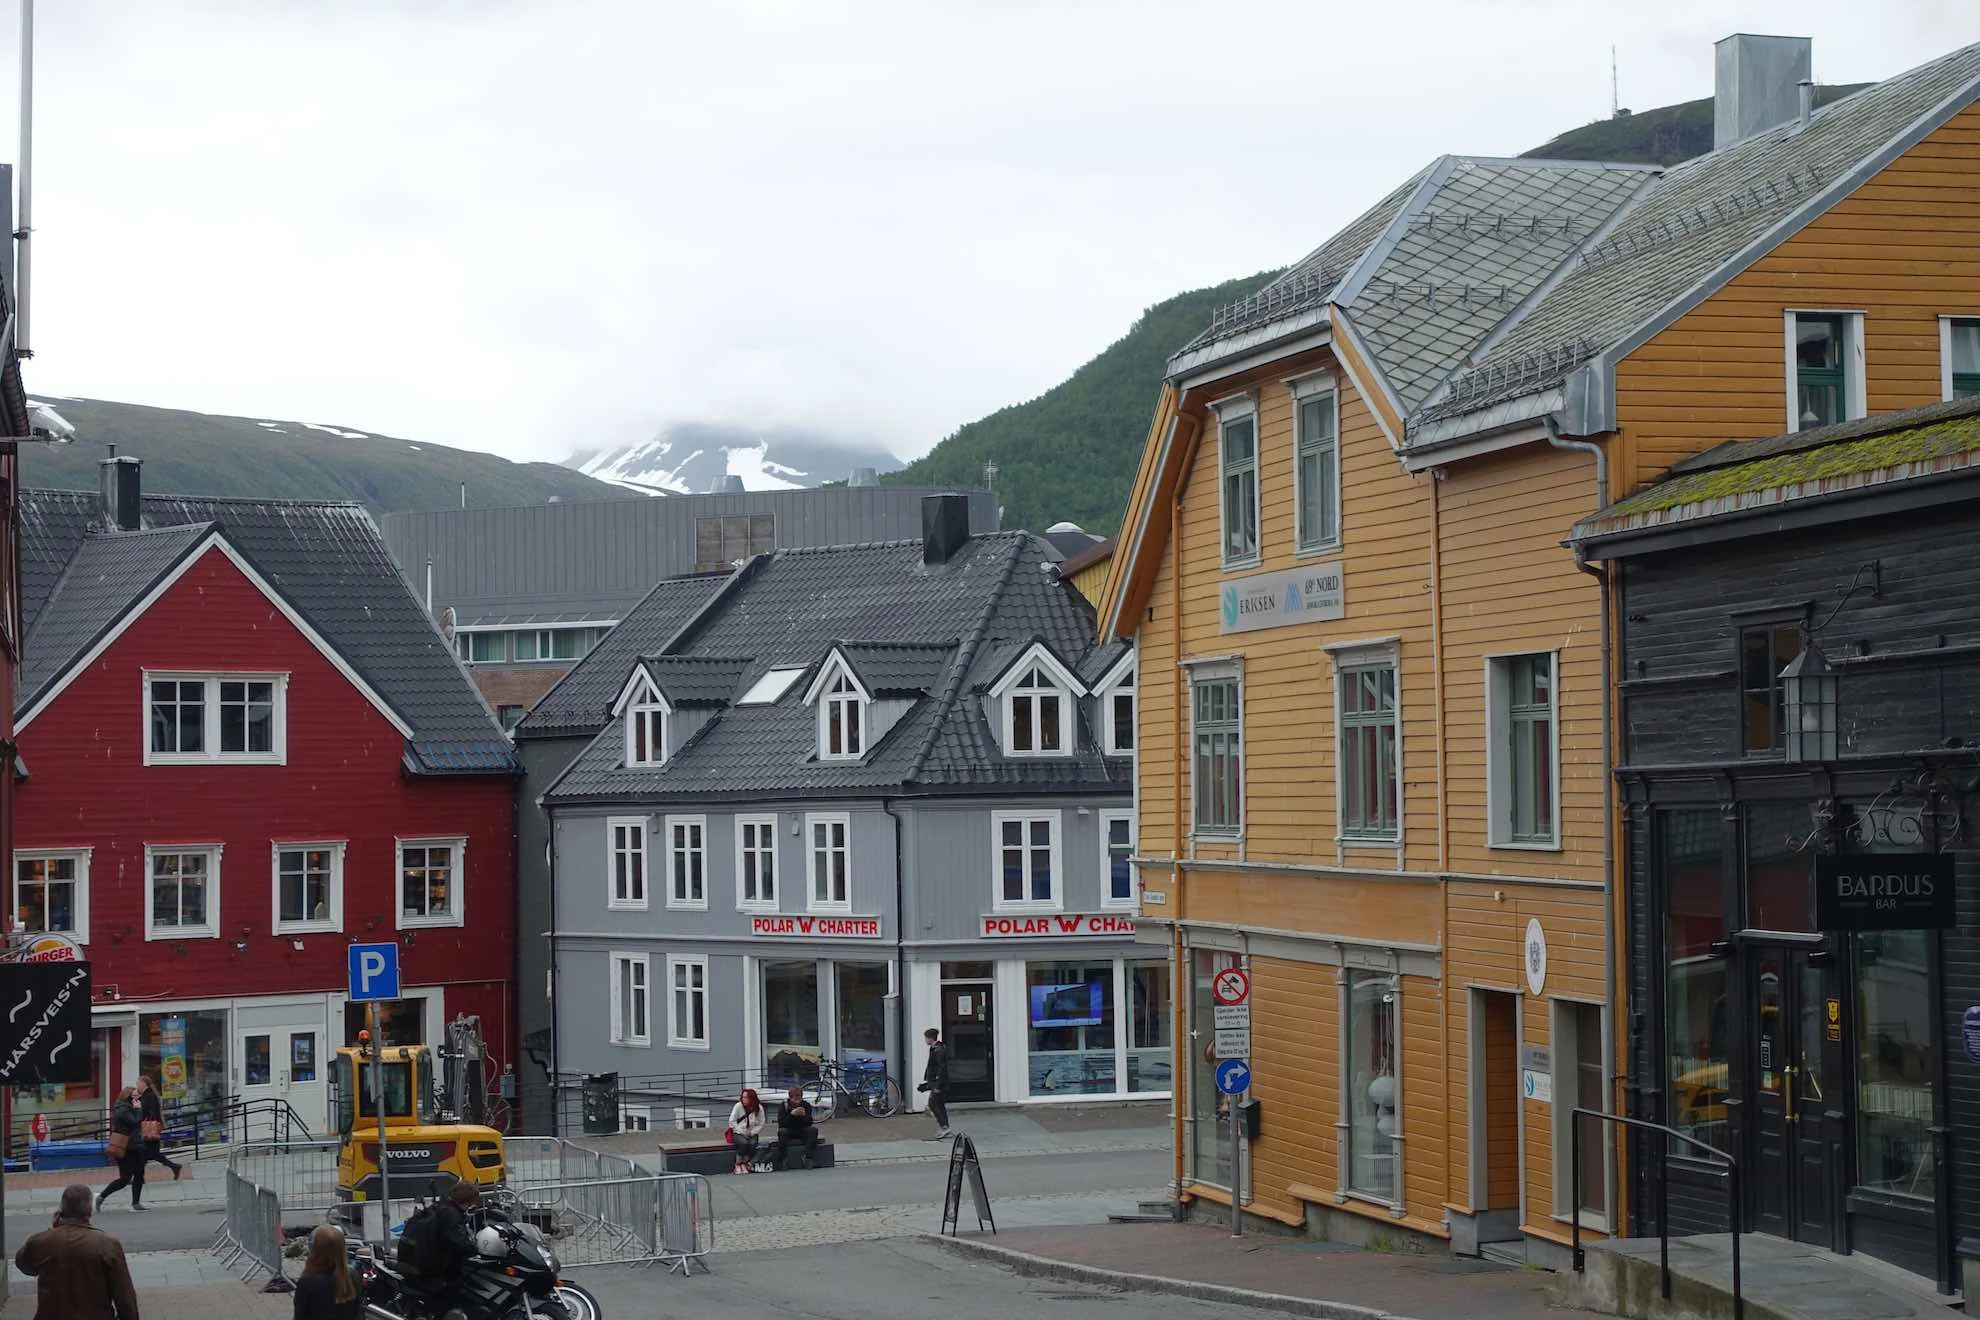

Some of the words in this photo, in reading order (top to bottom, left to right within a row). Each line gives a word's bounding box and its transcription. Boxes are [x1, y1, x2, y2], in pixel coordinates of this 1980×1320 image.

[1316, 575, 1339, 593] NORD
[1837, 874, 1935, 897] BARDUS
[1875, 898, 1898, 910] BAR
[753, 918, 794, 934] POLAR
[818, 919, 878, 935] CHARTER
[985, 918, 1050, 935] POLAR
[360, 951, 386, 993] P
[385, 1149, 431, 1159] VOLVO
